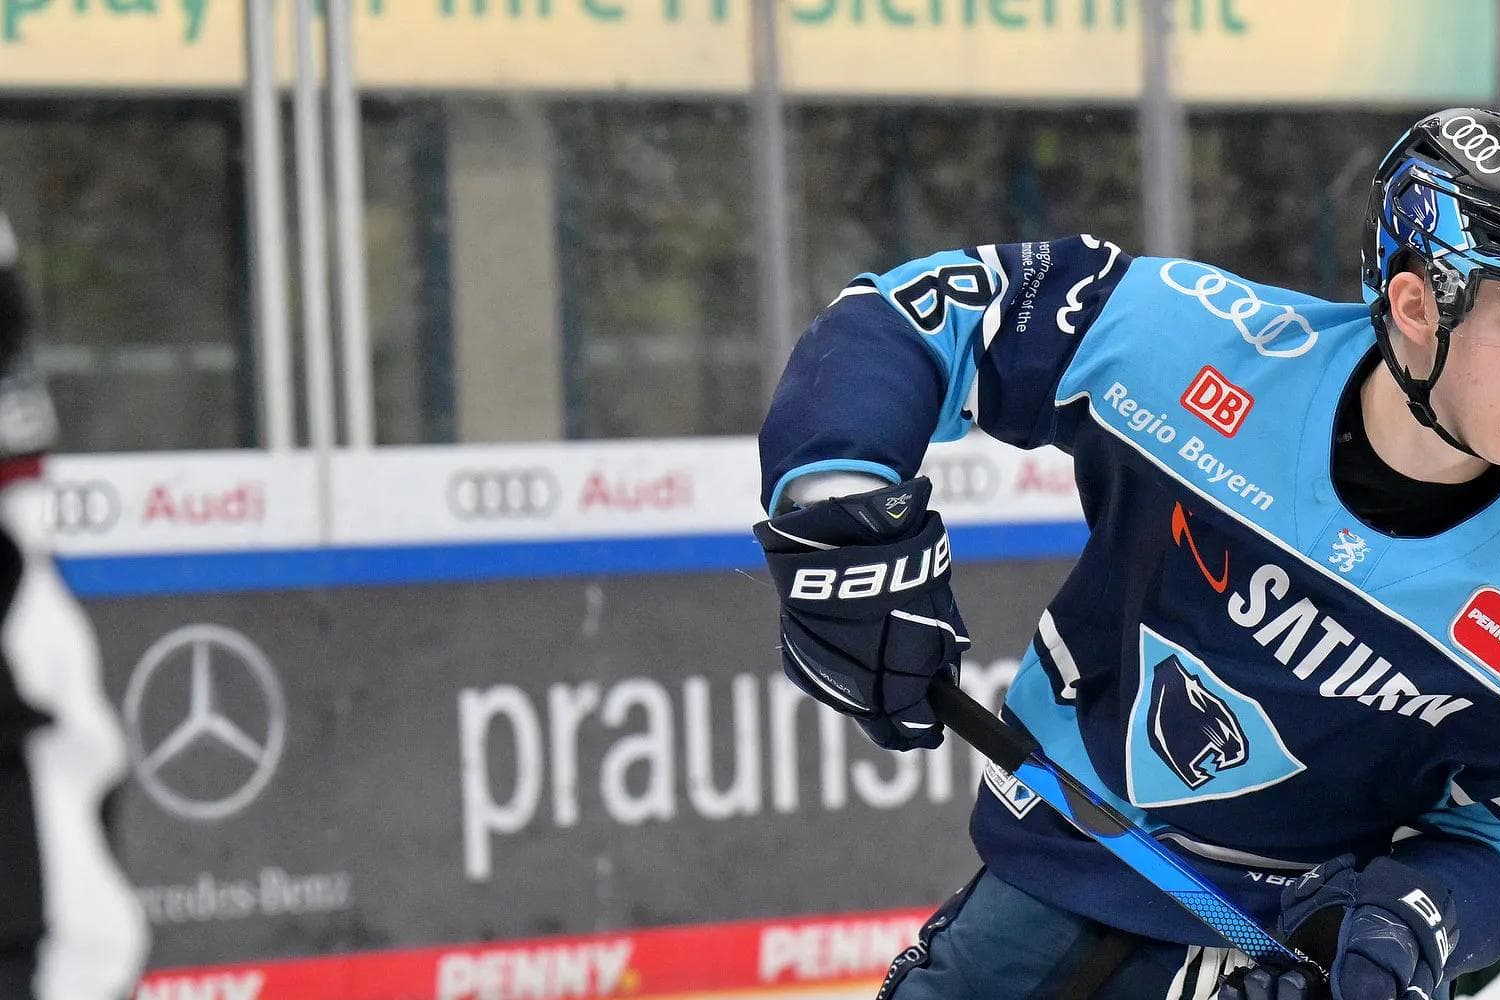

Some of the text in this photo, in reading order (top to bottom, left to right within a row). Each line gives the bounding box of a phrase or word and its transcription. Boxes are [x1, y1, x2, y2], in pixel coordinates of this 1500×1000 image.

[1188, 373, 1244, 428] DB
[1103, 381, 1275, 512] Regio Bayern
[143, 483, 264, 524] Audi
[578, 471, 695, 512] Audi
[1015, 458, 1076, 496] Au
[789, 531, 952, 600] BAUE
[1227, 563, 1475, 728] SATURN
[756, 921, 924, 980] PENN
